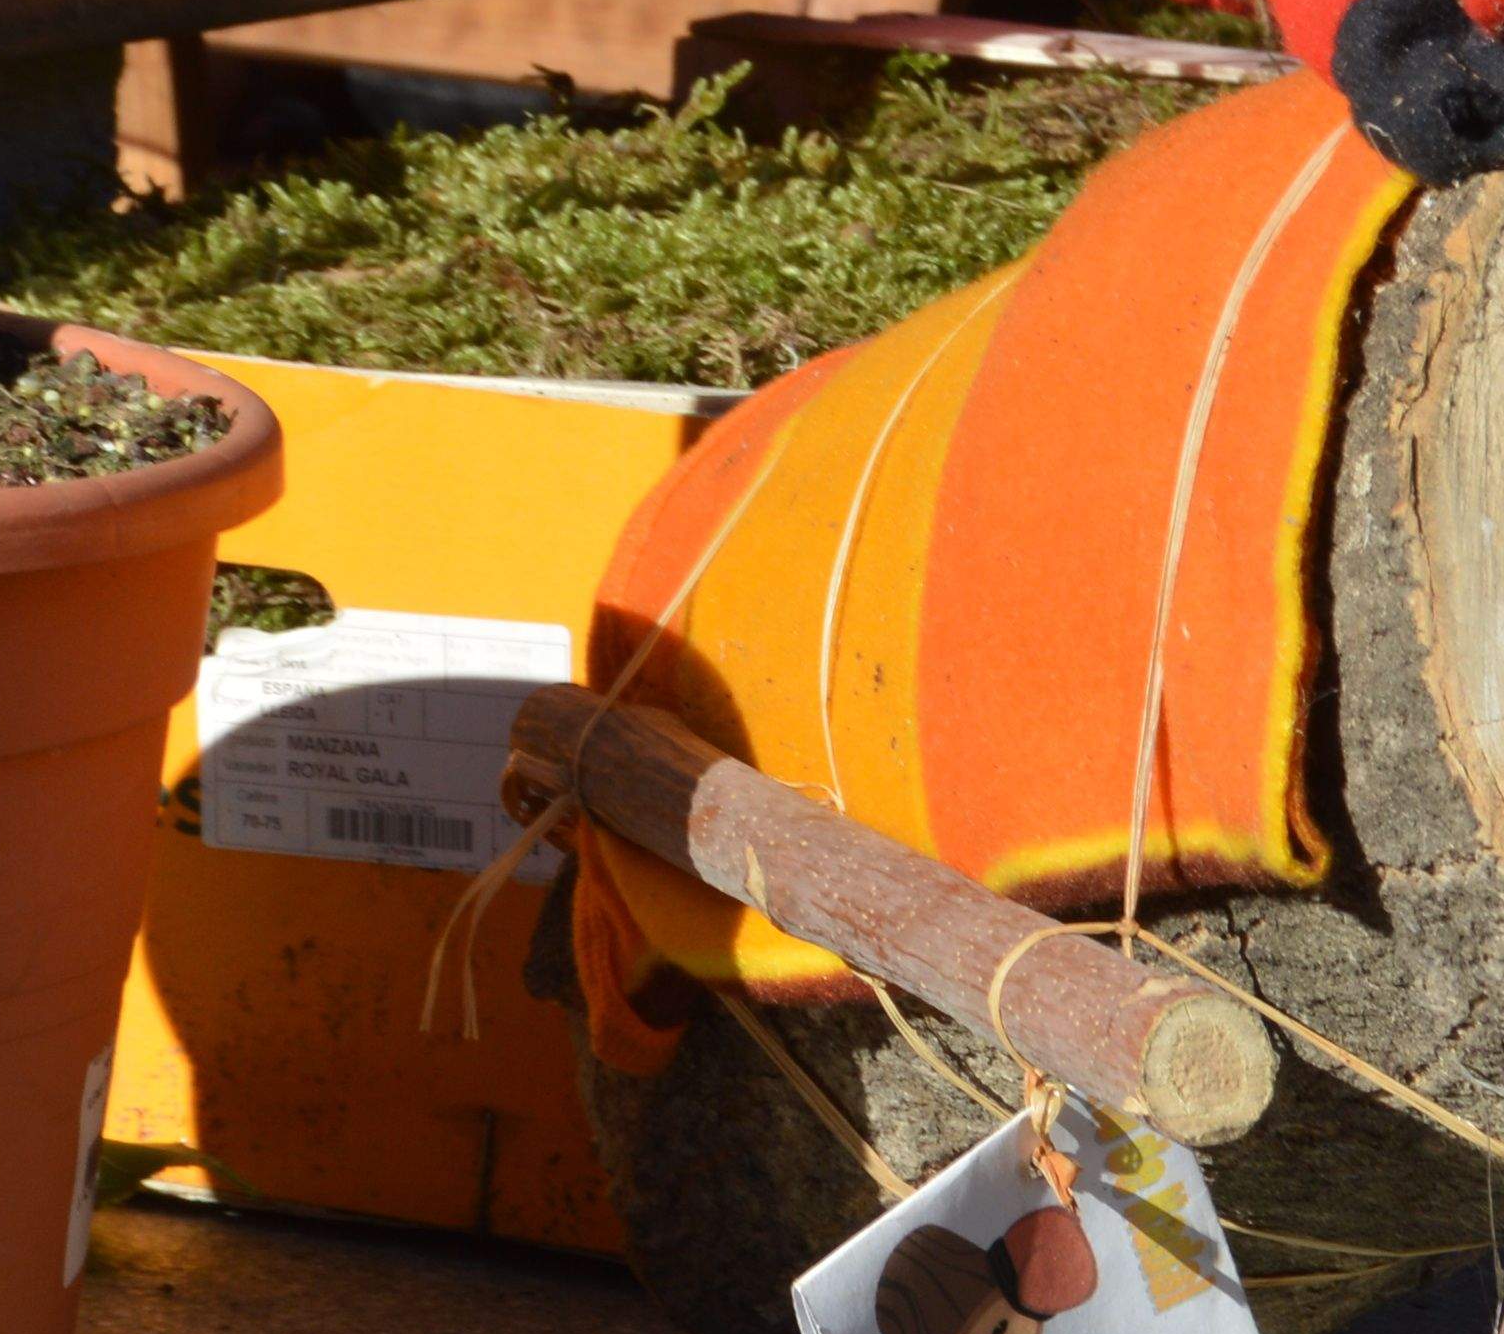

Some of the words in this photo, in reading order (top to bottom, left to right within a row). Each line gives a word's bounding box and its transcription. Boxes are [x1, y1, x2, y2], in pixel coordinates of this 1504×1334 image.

[287, 734, 381, 758] MANZANA
[287, 760, 351, 783] ROYAL
[355, 766, 409, 787] GALA
